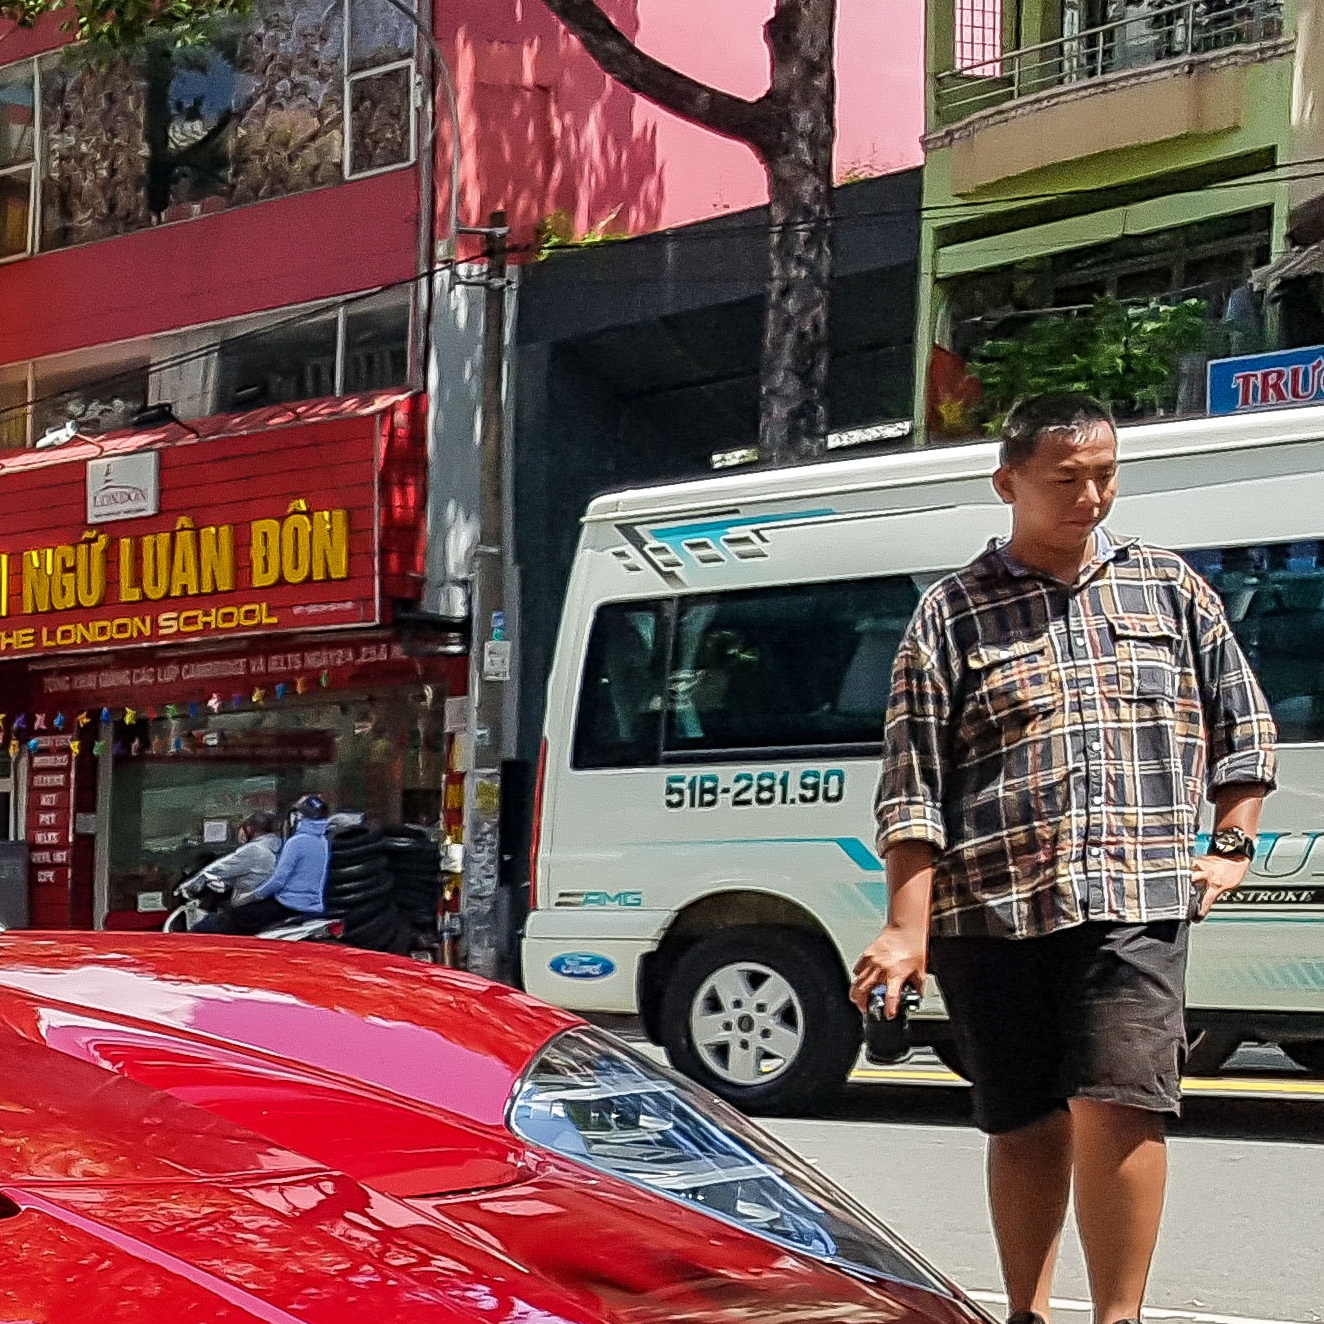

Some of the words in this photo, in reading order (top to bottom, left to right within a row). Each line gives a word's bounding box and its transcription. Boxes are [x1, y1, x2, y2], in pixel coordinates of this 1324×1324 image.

[1231, 355, 1324, 409] TRƯ
[22, 529, 110, 614] NGỮ
[120, 516, 235, 602] LUÂN
[250, 499, 349, 588] ĐÔN
[43, 616, 151, 647] LONDON
[158, 602, 278, 635] SCHOOL
[665, 769, 845, 808] 51B-281.90
